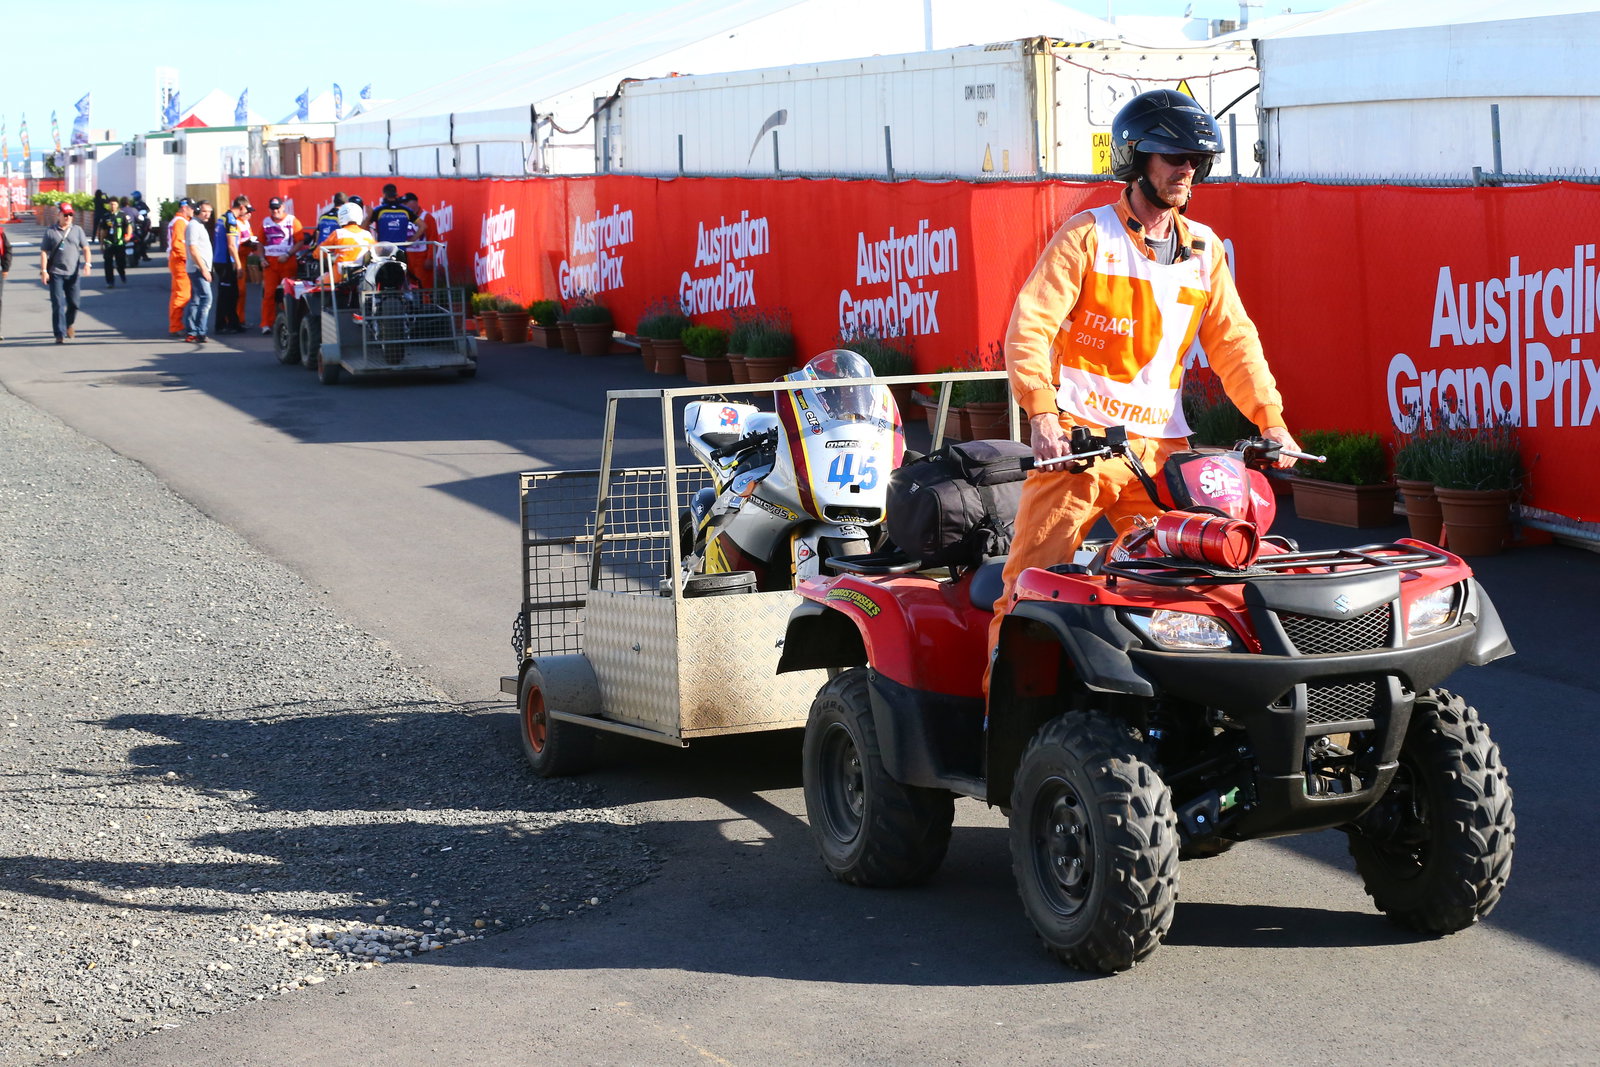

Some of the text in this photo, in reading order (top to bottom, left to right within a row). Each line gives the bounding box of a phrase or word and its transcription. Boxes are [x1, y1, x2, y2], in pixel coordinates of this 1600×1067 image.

[1093, 134, 1112, 147] CAU
[573, 204, 634, 257] Australian
[694, 210, 769, 268] Australian
[856, 219, 958, 286] Australian
[559, 248, 624, 300] Grand Prix
[679, 260, 756, 317] Grand Prix
[1430, 244, 1600, 348] Australi
[839, 279, 939, 342] Grand Prix
[1084, 310, 1138, 338] TRACK
[1076, 332, 1105, 350] 2013
[1084, 390, 1170, 425] AUSTRALIA
[1387, 352, 1521, 434] Grand
[805, 411, 820, 428] elf
[827, 453, 879, 490] 45
[826, 588, 881, 616] CHRISTENSEN'S
